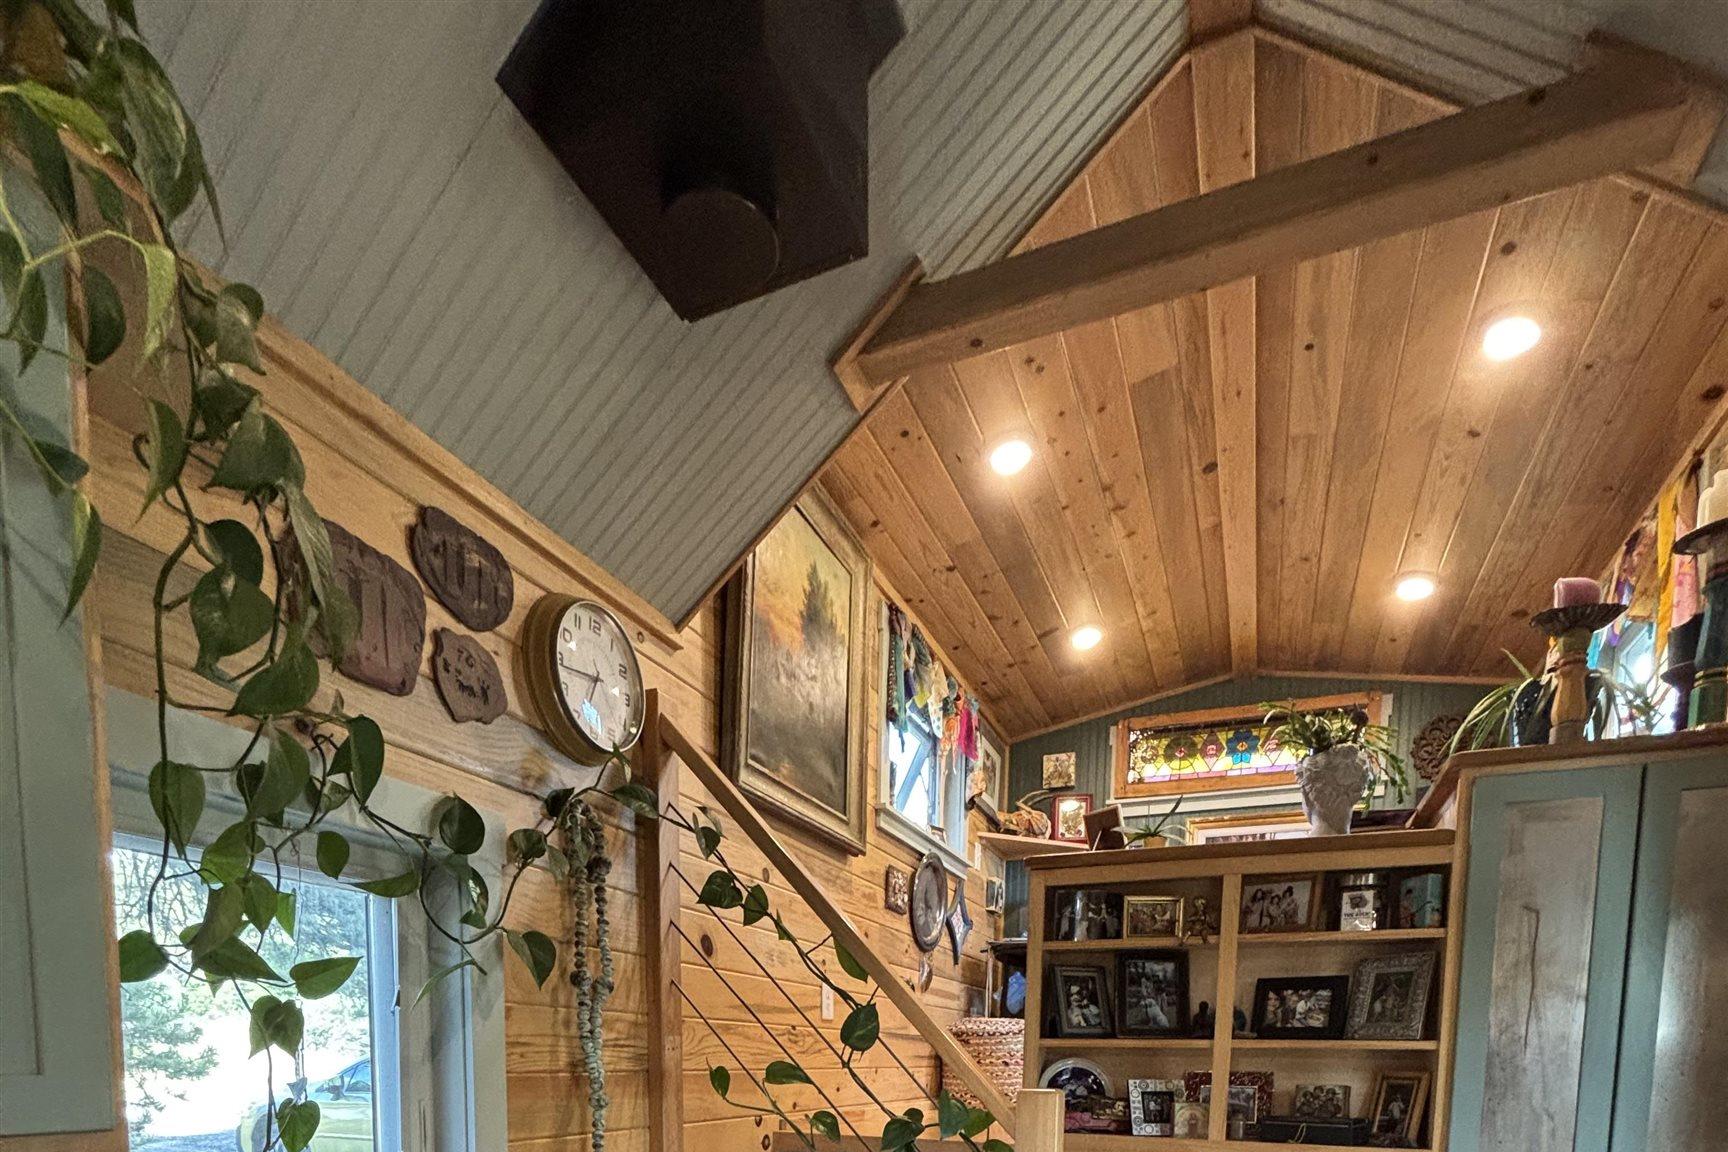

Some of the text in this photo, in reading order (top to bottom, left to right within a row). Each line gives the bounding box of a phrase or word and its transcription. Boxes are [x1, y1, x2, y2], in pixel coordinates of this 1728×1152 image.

[573, 612, 582, 631] 11
[589, 615, 602, 637] 12
[560, 627, 573, 643] 10
[619, 663, 628, 680] 2
[624, 692, 631, 708] 3
